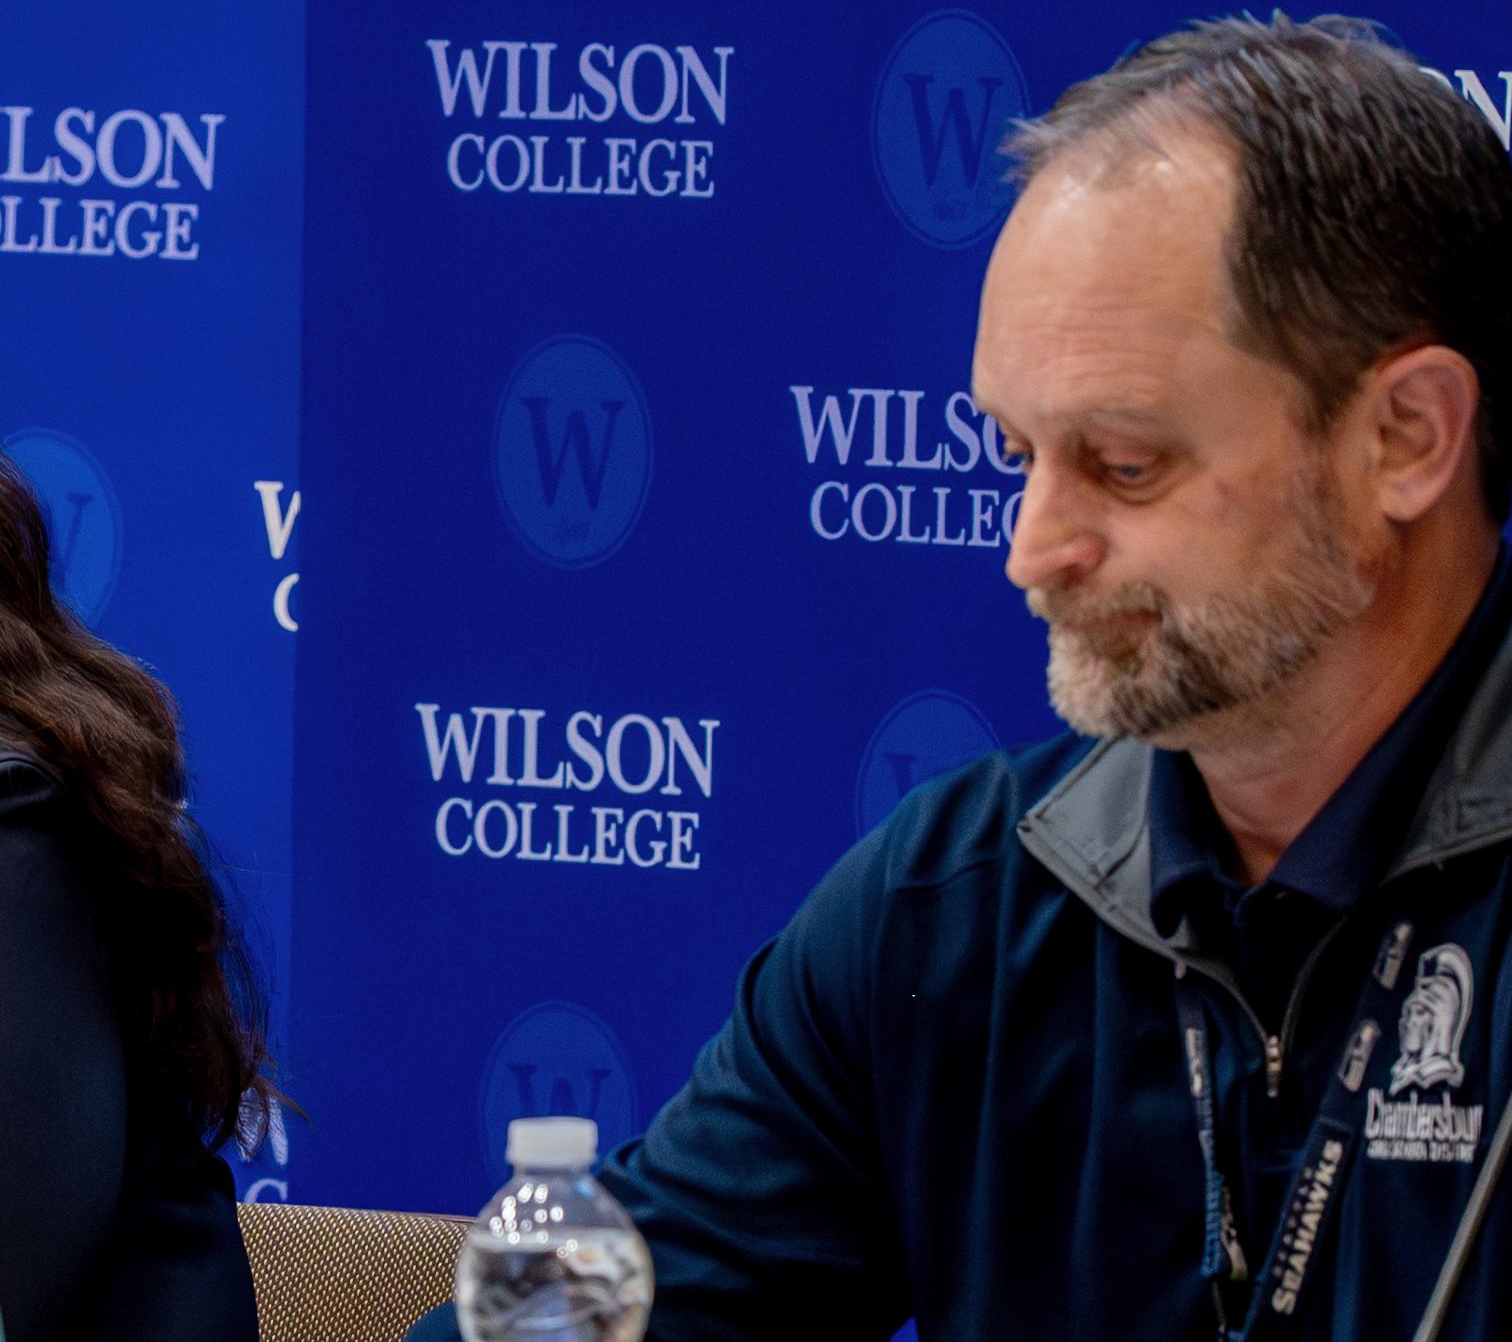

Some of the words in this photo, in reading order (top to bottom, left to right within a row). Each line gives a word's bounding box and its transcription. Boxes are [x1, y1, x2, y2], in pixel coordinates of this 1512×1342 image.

[426, 40, 734, 124] WILSON
[448, 133, 714, 197] COLLEGE
[903, 74, 1002, 186] W
[522, 397, 625, 509] W
[809, 481, 1026, 548] COLLE
[415, 703, 720, 797] WILSON
[436, 798, 700, 869] COLLEGE
